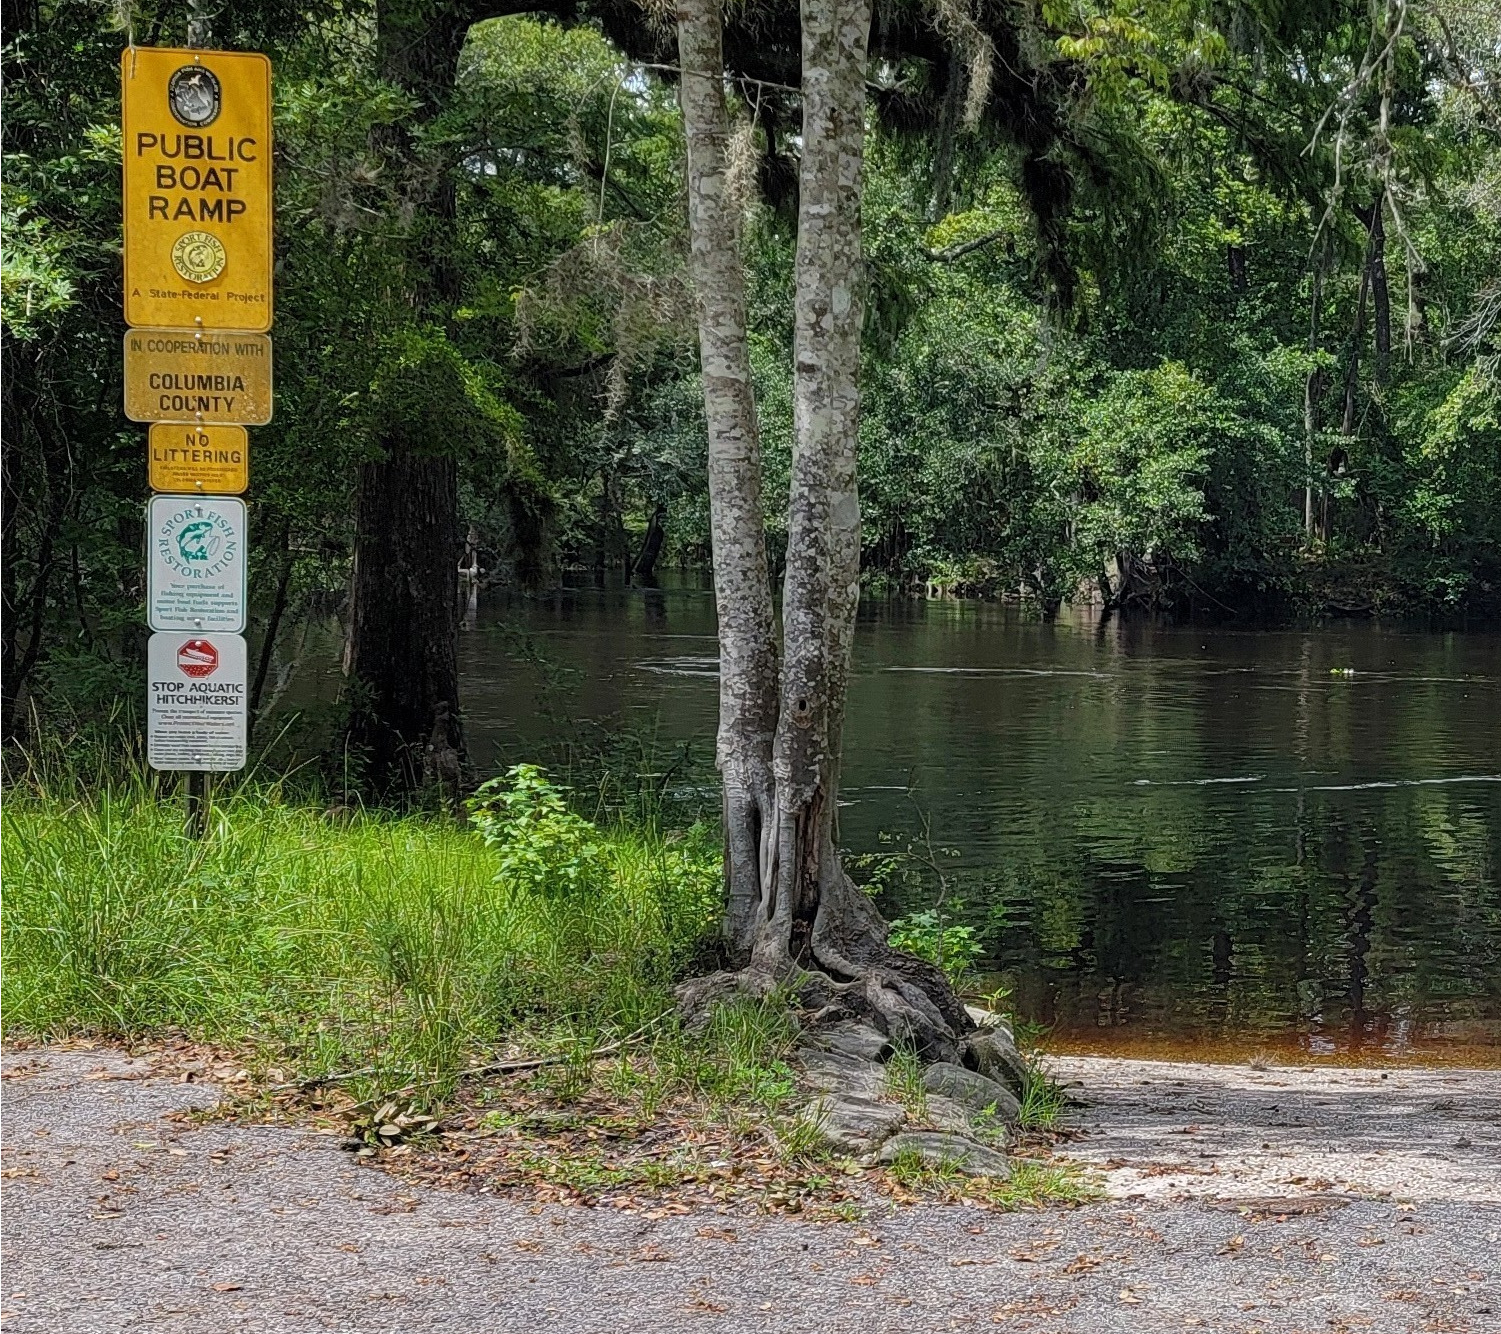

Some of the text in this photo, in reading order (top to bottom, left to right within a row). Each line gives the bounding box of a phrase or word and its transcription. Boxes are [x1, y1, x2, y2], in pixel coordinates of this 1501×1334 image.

[137, 133, 257, 162] PUBLIC
[156, 165, 238, 192] BOAT
[149, 196, 246, 223] RAMP
[175, 234, 222, 253] SPORT FISH
[132, 288, 265, 304] A State-Federal Project
[131, 339, 263, 356] IN COOPERATION WITH
[149, 373, 244, 392] COLUMBIA
[160, 395, 235, 413] COUNTY
[185, 434, 209, 447] NO
[153, 449, 241, 463] LITTERING
[162, 509, 235, 538] SPORT FISH
[159, 539, 237, 578] RESTORATION
[152, 682, 243, 694] STOP AQUATIC
